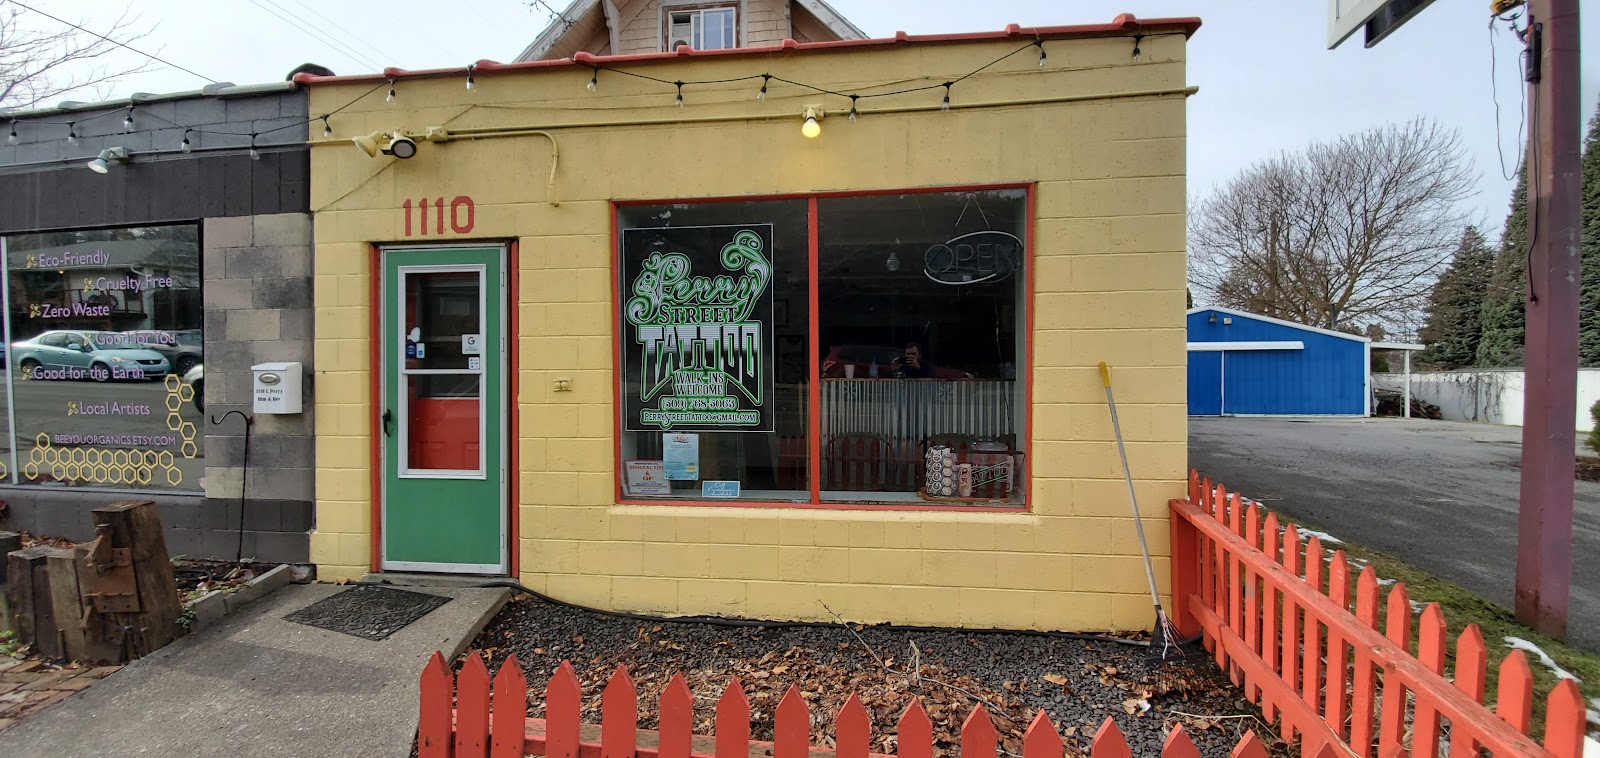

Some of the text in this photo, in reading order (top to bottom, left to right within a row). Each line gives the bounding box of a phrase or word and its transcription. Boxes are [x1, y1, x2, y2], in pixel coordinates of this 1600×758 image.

[402, 195, 475, 236] 1110
[39, 250, 110, 267] Eco-Friendly
[924, 243, 1020, 272] OPEN
[96, 275, 173, 293] Cruelty Free
[627, 230, 770, 323] Perry
[41, 302, 110, 318] Zero Waste
[658, 303, 738, 324] STREET
[95, 331, 176, 345] Good for You
[638, 322, 761, 403] TATTOO
[33, 365, 145, 380] Good for the Earth
[674, 371, 724, 384] WALK-INS
[675, 383, 724, 396] WELCOME
[80, 401, 151, 415] Local Artists
[662, 398, 688, 411] (509)
[54, 434, 176, 446] BEEYOUORGANICS.ETSY.COM
